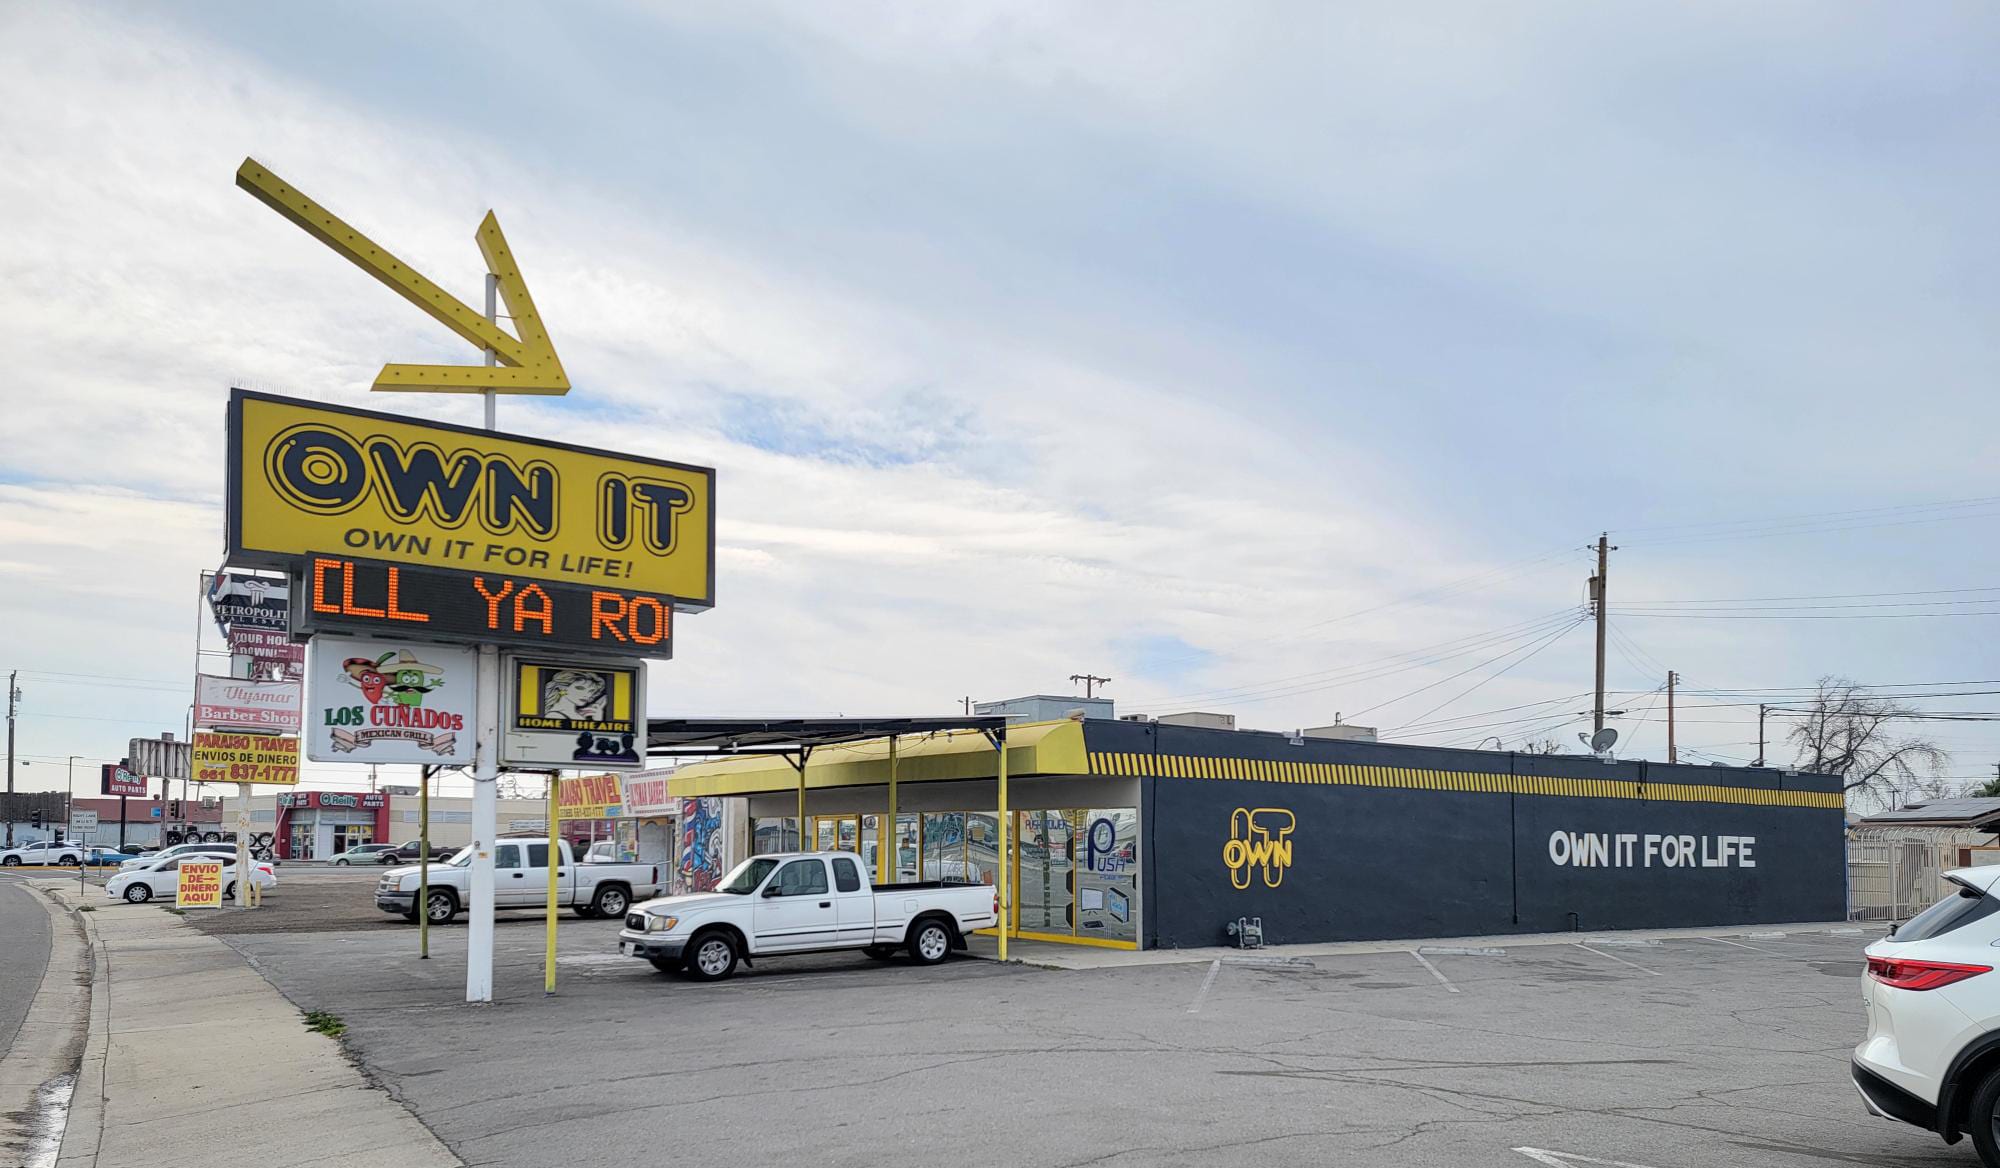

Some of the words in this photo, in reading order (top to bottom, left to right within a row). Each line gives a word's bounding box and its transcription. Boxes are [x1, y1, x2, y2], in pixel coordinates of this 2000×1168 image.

[264, 422, 560, 542] OWN
[596, 471, 695, 557] IT
[343, 528, 432, 556] OWN
[443, 539, 474, 560] IT
[483, 543, 551, 569] FOR
[560, 553, 634, 578] LIFE!
[215, 604, 288, 619] ETROPOLIT
[473, 576, 553, 634] YA
[591, 591, 669, 644] RO
[233, 632, 263, 644] YOUR
[200, 706, 257, 721] Barber
[260, 710, 299, 725] Shop
[324, 705, 365, 726] LOS
[369, 702, 464, 731] CUÑADOS
[519, 717, 563, 729] HOME
[571, 720, 631, 732] THEATRE
[360, 729, 401, 739] MEXICAN
[403, 730, 428, 740] GRILL
[194, 732, 250, 750] PARAISO
[252, 736, 298, 753] TRAVEL
[194, 750, 236, 762] ENVIOS
[239, 752, 254, 763] DE
[257, 753, 297, 765] DINERO
[199, 769, 226, 780] 661
[230, 763, 297, 782] 837-1777
[111, 784, 127, 793] AUTO
[127, 786, 146, 794] PARTS
[319, 793, 359, 808] O'Reilly
[1223, 839, 1293, 869] OWN
[1549, 830, 1609, 868] OWN
[1615, 834, 1638, 868] IT
[1644, 834, 1697, 868] FOR
[1702, 835, 1756, 868] LIFE
[181, 864, 219, 874] ENVIO
[188, 874, 204, 883] DE
[180, 883, 220, 892] DINERO
[183, 893, 214, 902] AQUI
